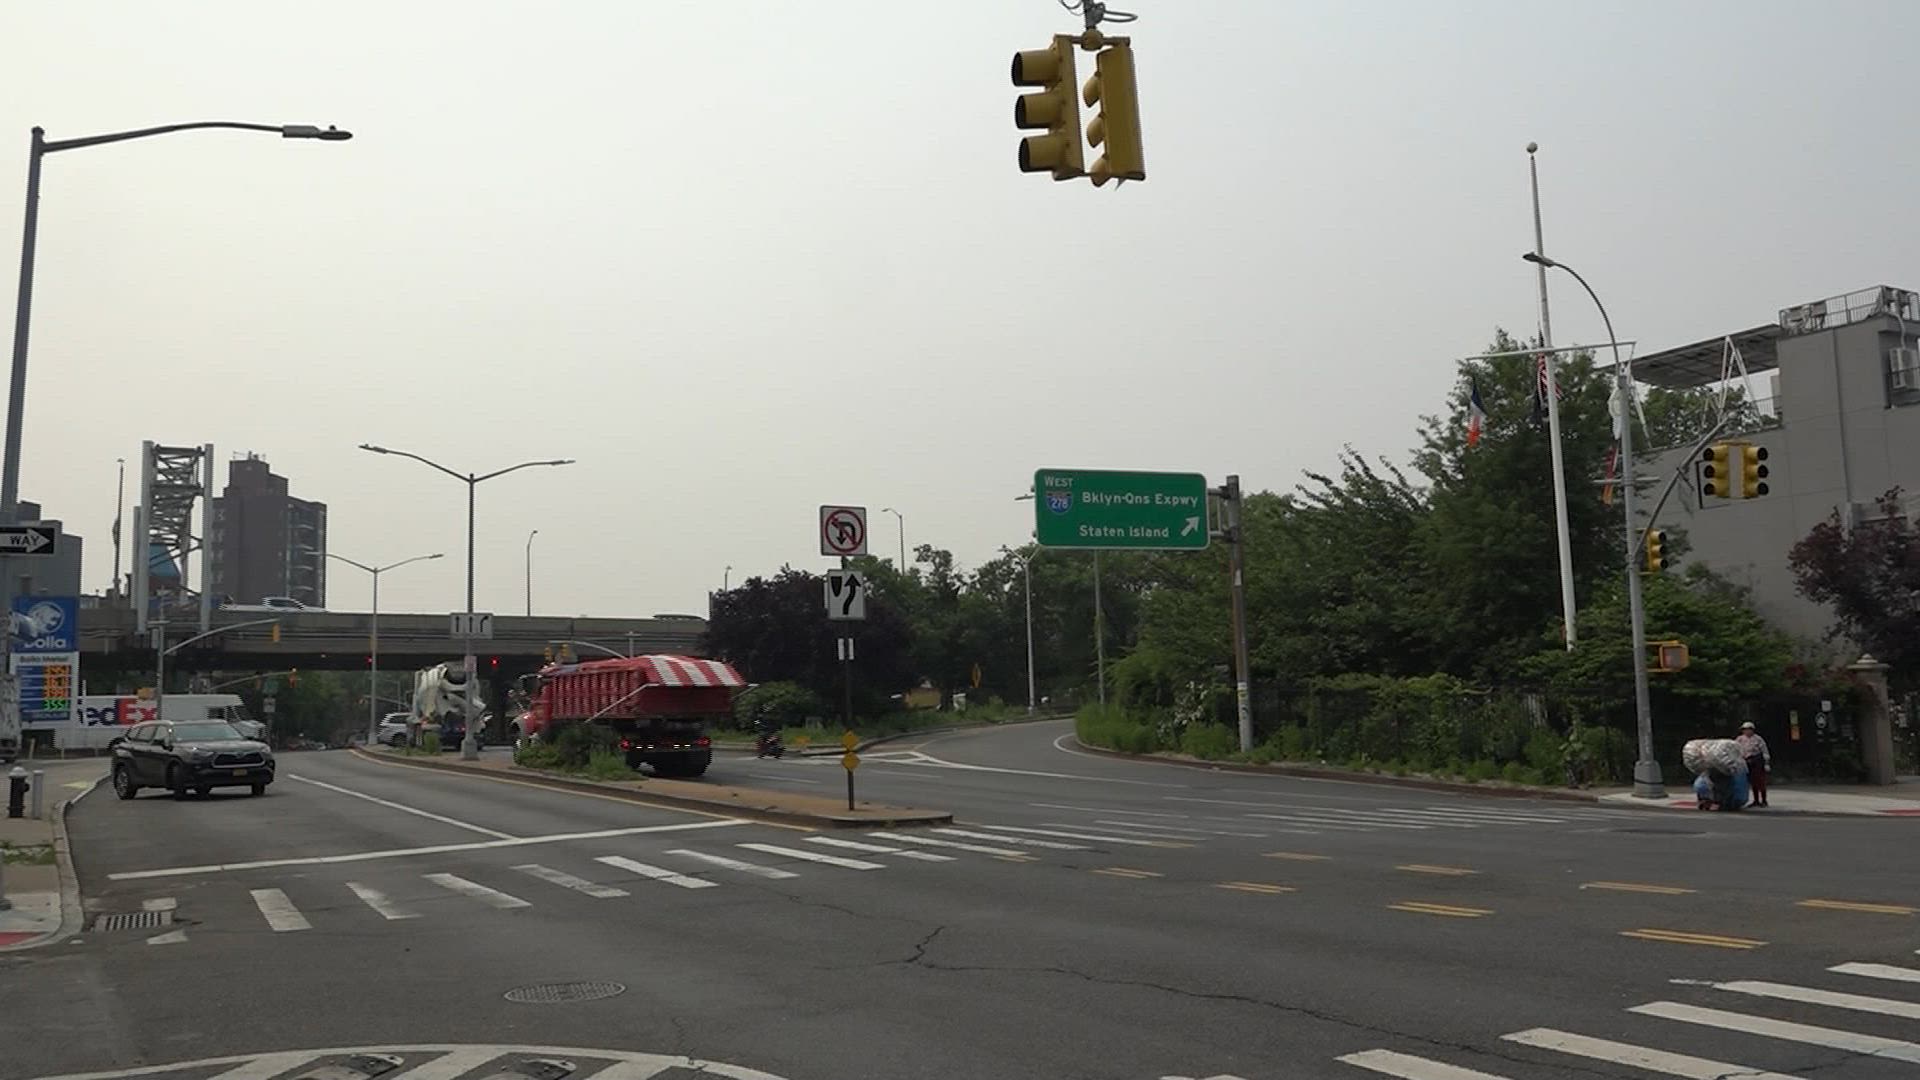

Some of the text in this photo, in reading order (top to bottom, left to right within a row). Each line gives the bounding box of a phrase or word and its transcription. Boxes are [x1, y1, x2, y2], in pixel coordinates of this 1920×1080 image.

[1045, 475, 1075, 487] WEST
[1051, 497, 1068, 509] 278
[1082, 491, 1198, 508] Bklyn-Qns Expwy
[1079, 525, 1170, 538] Staten Island
[9, 535, 39, 546] WAY
